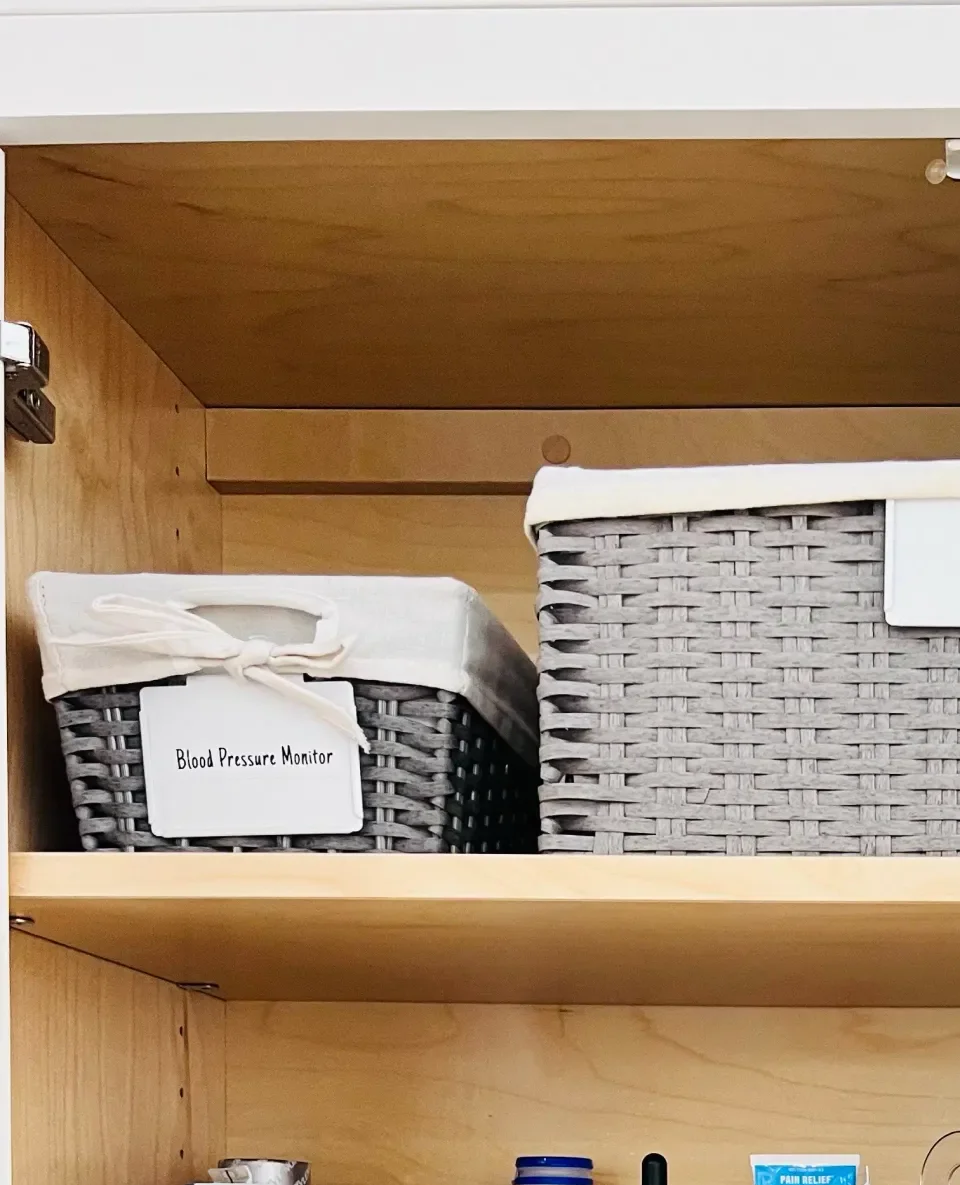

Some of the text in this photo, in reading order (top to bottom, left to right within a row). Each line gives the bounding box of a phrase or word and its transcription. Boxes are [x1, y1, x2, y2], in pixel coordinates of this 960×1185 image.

[176, 745, 334, 770] Blood Pressure Monitor
[780, 1175, 833, 1184] PAIN RELIEF
